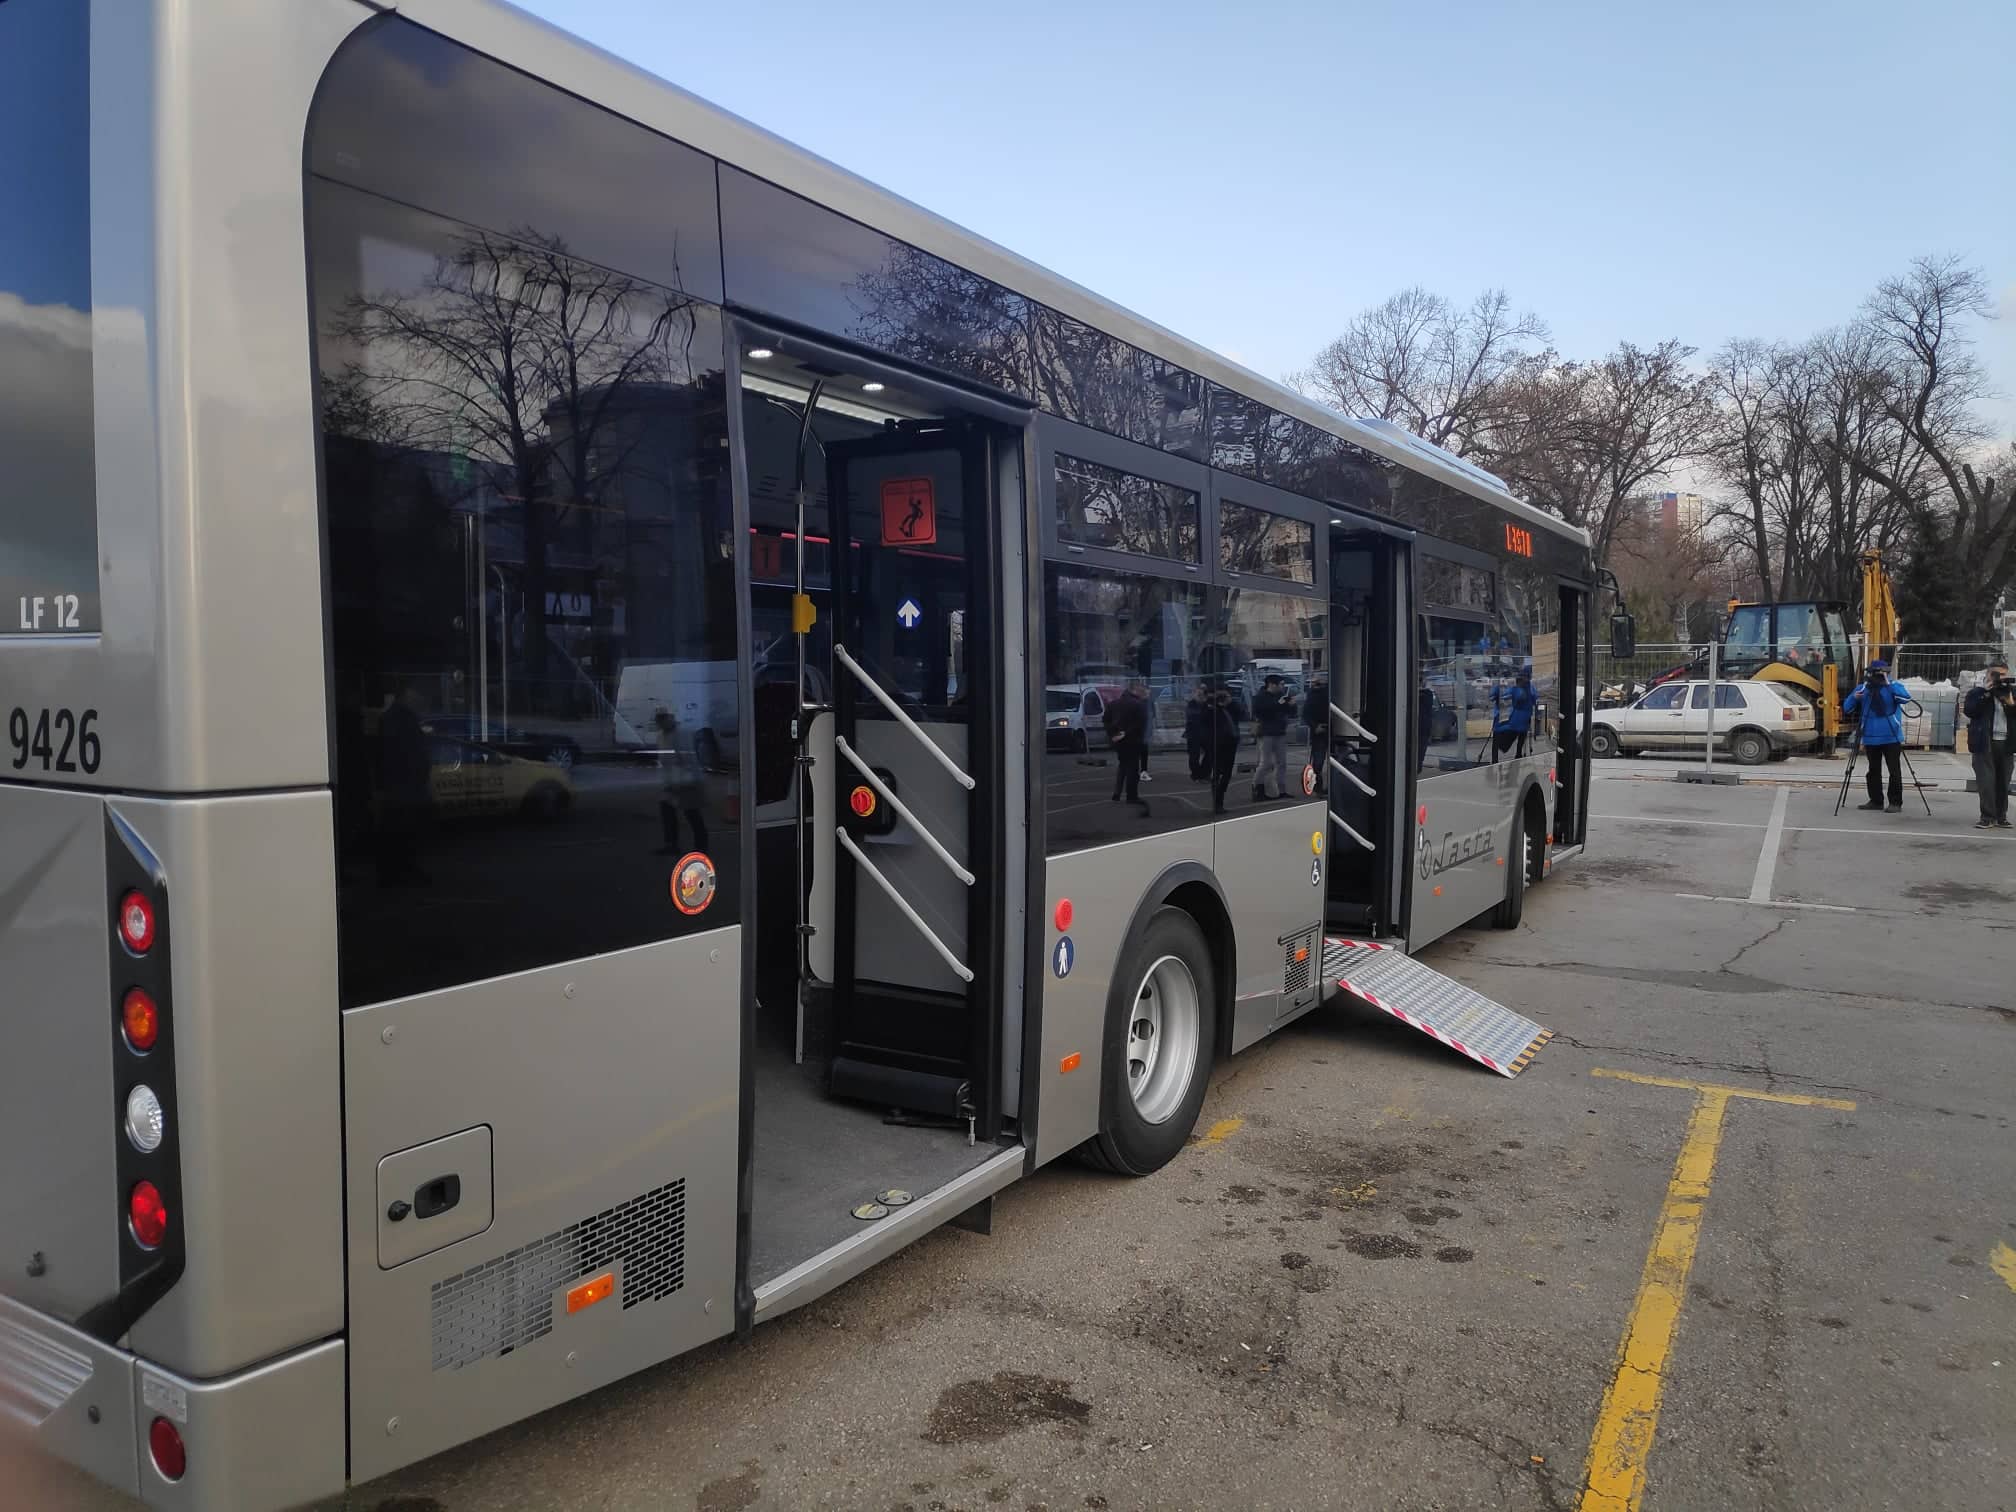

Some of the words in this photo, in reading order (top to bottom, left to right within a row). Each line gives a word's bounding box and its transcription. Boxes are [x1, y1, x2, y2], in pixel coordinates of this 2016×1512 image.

[20, 597, 45, 629] LF
[54, 595, 80, 628] 12
[9, 706, 101, 775] 9426
